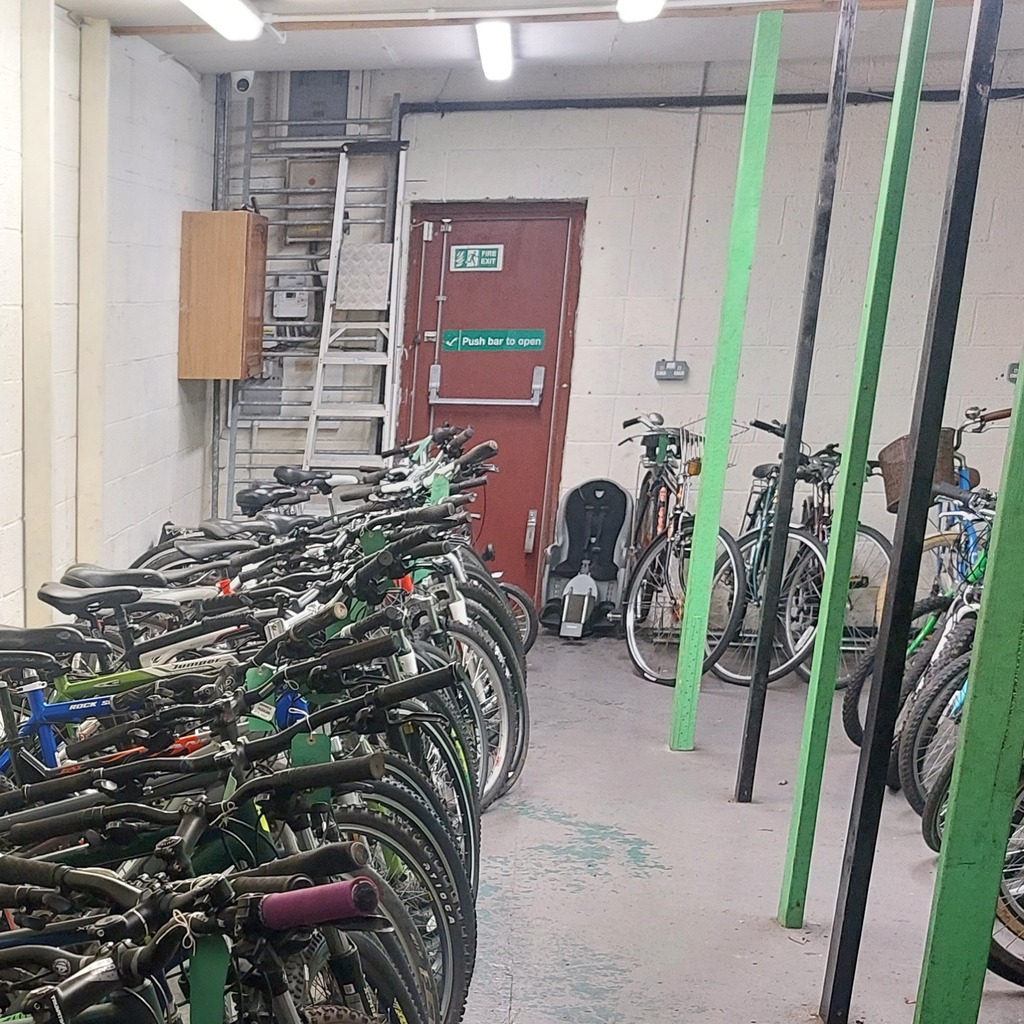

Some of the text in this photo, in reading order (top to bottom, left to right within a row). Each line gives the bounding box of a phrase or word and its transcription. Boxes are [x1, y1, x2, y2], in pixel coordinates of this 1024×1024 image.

[462, 336, 542, 347] Push bar to open
[69, 700, 97, 711] ROCK
